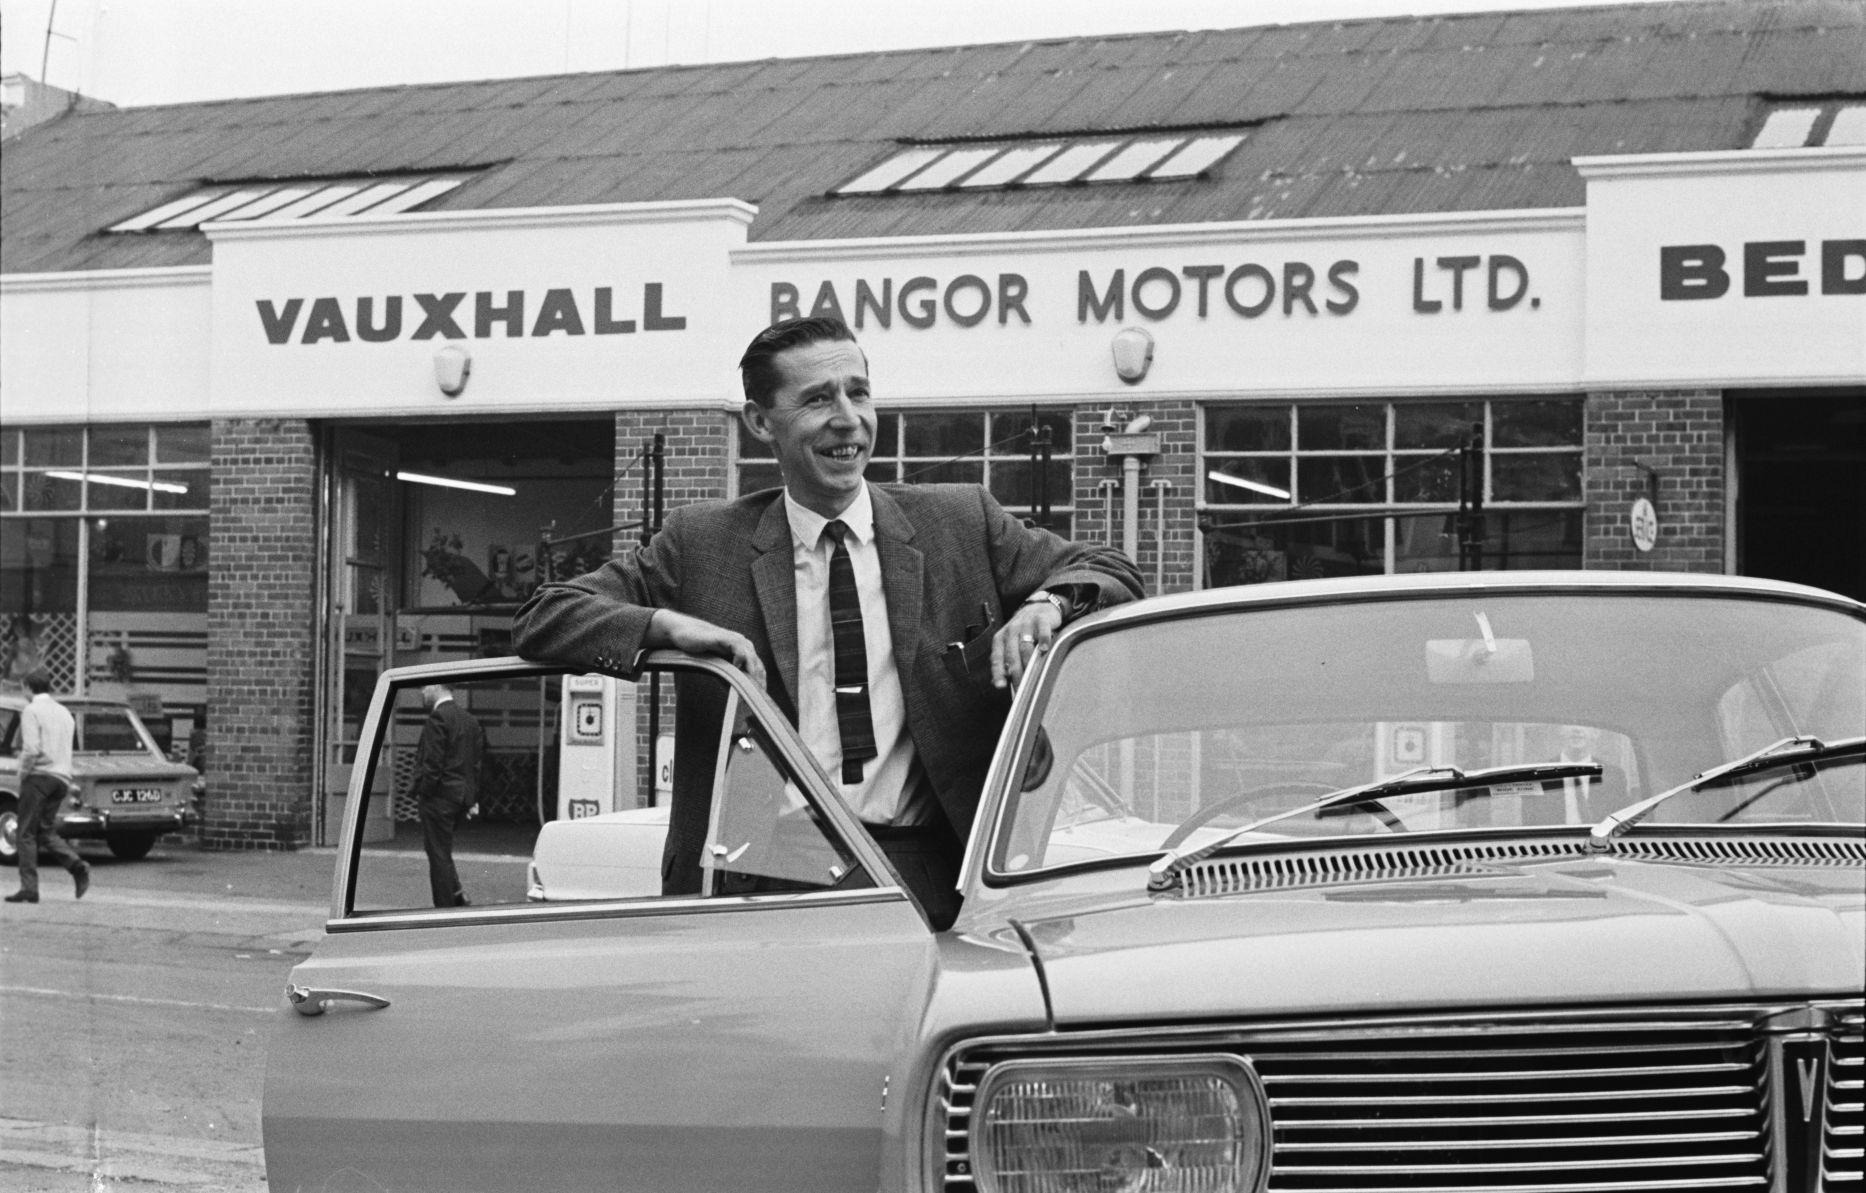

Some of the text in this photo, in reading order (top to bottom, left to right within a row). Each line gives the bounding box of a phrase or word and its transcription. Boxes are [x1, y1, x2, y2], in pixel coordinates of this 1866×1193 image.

[770, 254, 1541, 330] BANGOR MOTORS LTD.
[255, 282, 687, 345] VAUXHALL
[112, 790, 133, 802] CJC
[572, 803, 598, 818] BP
